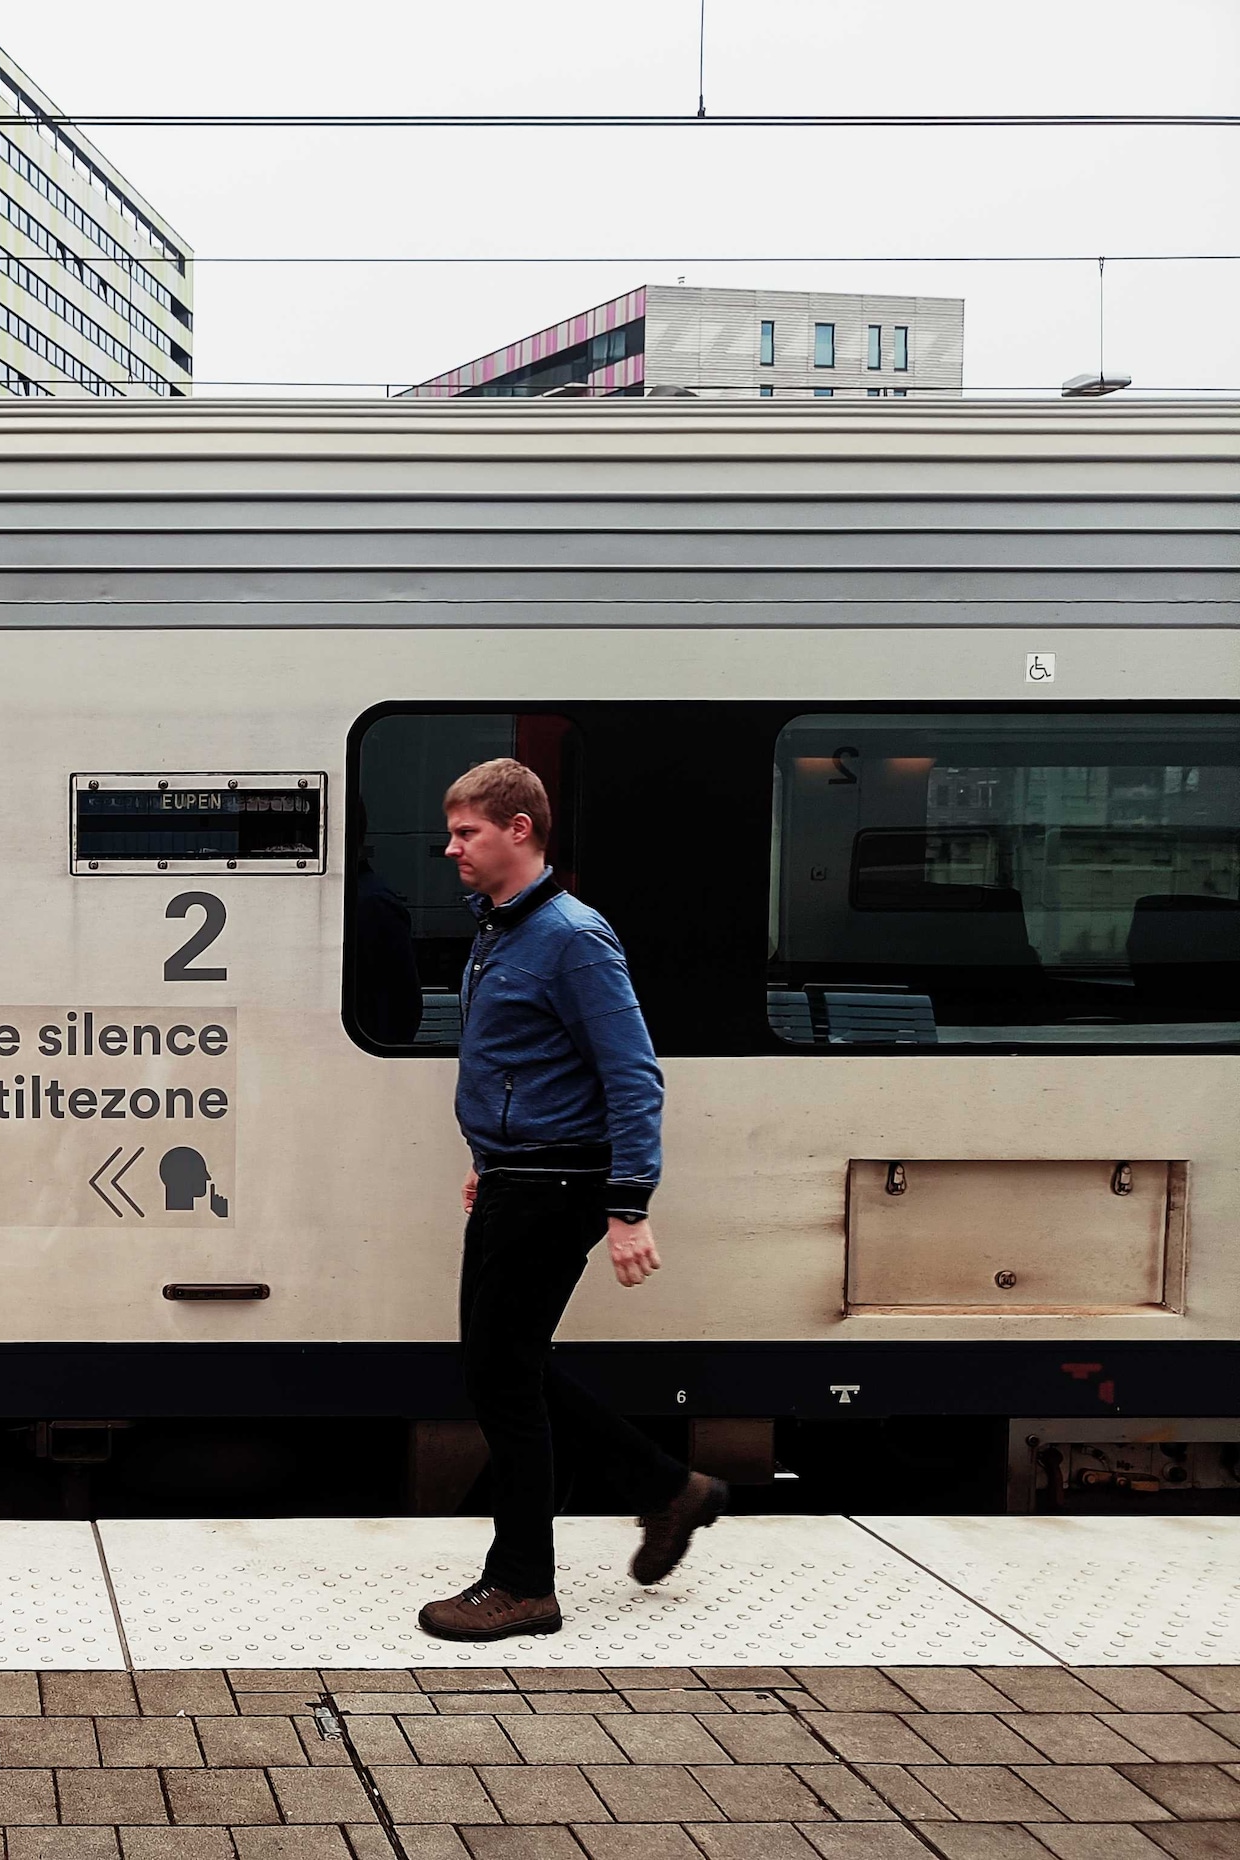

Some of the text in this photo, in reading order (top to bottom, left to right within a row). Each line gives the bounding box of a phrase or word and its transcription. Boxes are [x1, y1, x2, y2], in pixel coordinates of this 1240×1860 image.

[162, 793, 221, 809] EUPEN
[164, 892, 227, 981] 2
[38, 1012, 228, 1056] silence
[677, 1390, 686, 1403] 6
